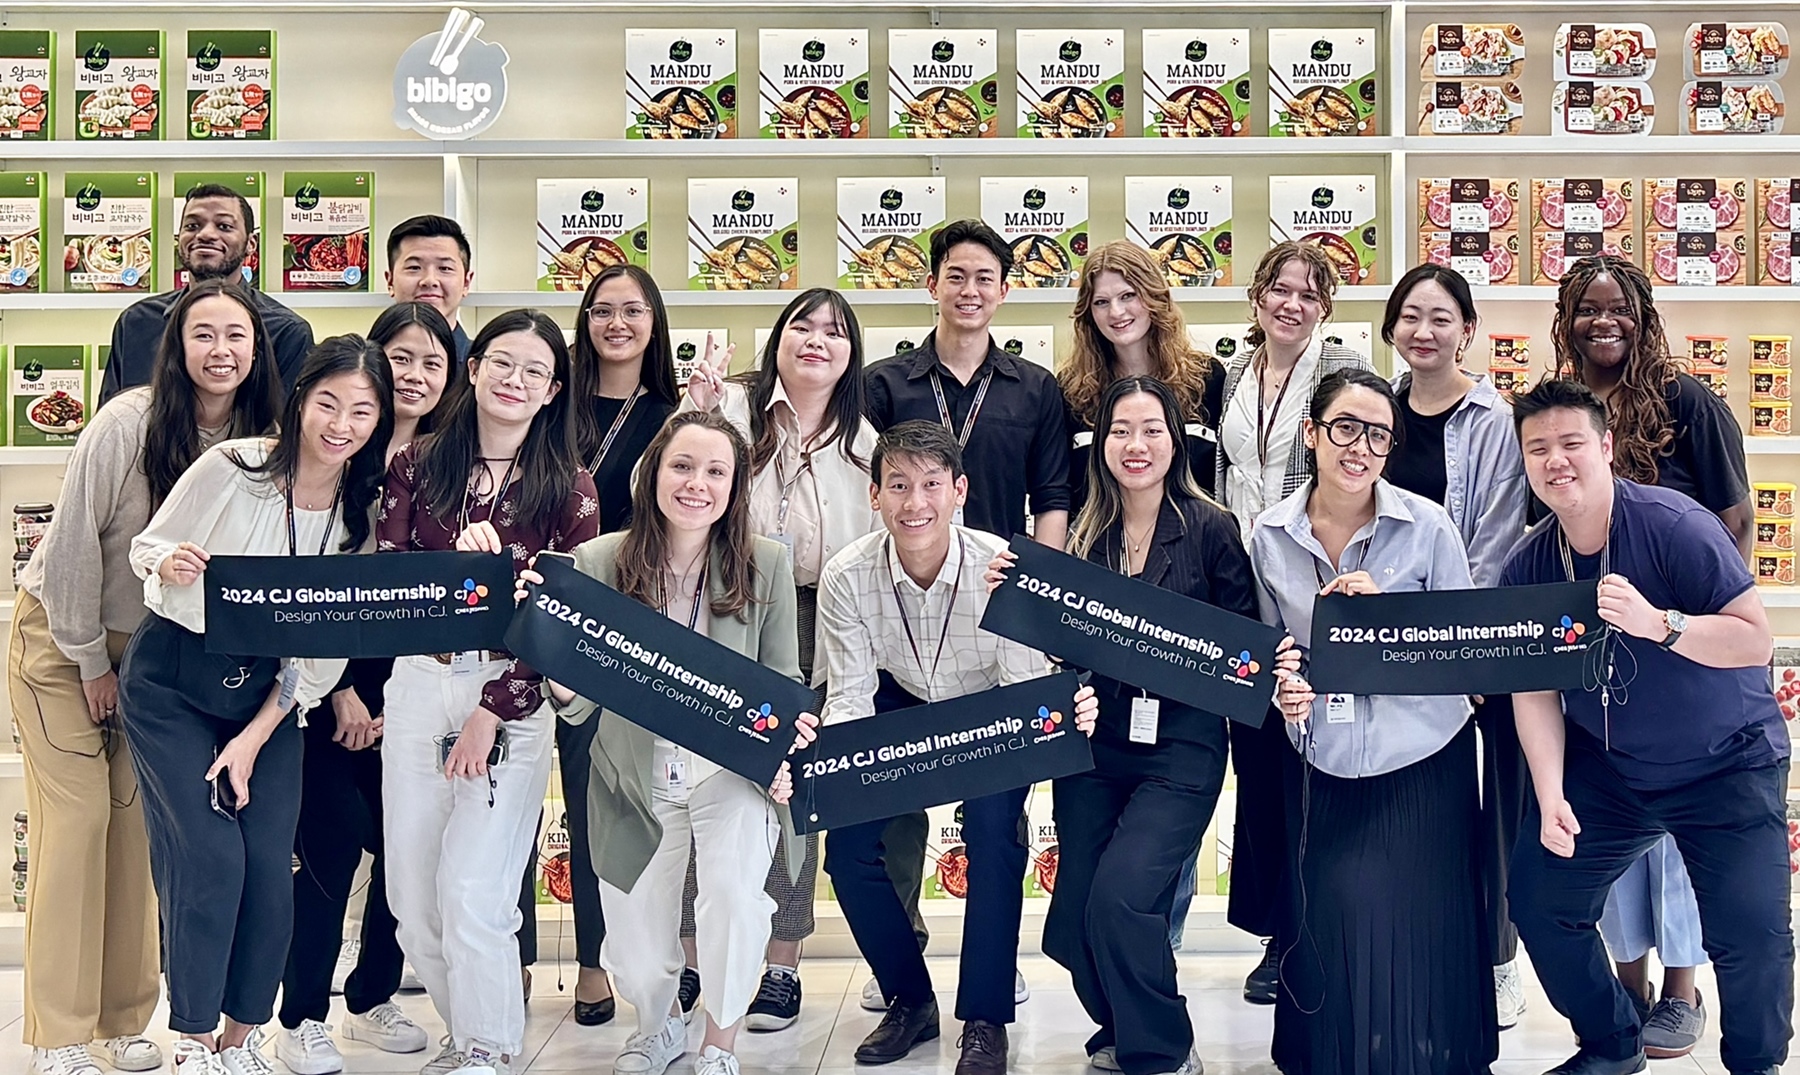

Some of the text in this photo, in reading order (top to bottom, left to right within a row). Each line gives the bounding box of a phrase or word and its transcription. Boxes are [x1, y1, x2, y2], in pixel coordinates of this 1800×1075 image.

[10, 66, 47, 82] 왕교자
[120, 65, 158, 82] 왕교자
[232, 65, 269, 82] 왕교자
[650, 65, 712, 78] MANDU
[784, 65, 844, 78] MANDU
[913, 65, 973, 78] MANDU
[1041, 65, 1100, 78] MANDU
[1166, 64, 1226, 77] MANDU
[1292, 64, 1352, 77] MANDU
[80, 73, 114, 84] 비비고
[192, 73, 225, 84] 비비고
[407, 77, 491, 111] bibigo
[72, 213, 105, 223] 비비고
[291, 212, 323, 222] 비비고
[561, 215, 623, 228] MANDU
[712, 214, 774, 227] MANDU
[861, 213, 922, 227] MANDU
[1005, 212, 1065, 226] MANDU
[1149, 212, 1209, 225] MANDU
[1293, 211, 1352, 224] MANDU
[221, 582, 447, 604] 2024 CJ Global Internship
[454, 589, 468, 601] CJ
[274, 610, 322, 624] Design
[323, 609, 357, 622] Your
[358, 607, 411, 621] Growth
[413, 607, 426, 618] in
[1016, 574, 1224, 661] 2024 CJ Global Internship
[1329, 620, 1545, 643] 2024 CJ Global Internship
[1552, 627, 1566, 639] CJ
[1060, 612, 1103, 637] Design
[1105, 628, 1135, 648] Your
[1135, 640, 1184, 666] Growth
[1184, 656, 1197, 670] in
[535, 594, 744, 710] 2024 CJ Global Internship
[1382, 649, 1426, 664] Design
[1428, 648, 1458, 661] Your
[1460, 645, 1510, 660] Growth
[1512, 644, 1525, 656] in
[1228, 657, 1242, 669] CJ
[575, 638, 619, 670] Design
[621, 661, 652, 684] Your
[651, 678, 701, 710] Growth
[700, 702, 714, 717] in
[746, 708, 761, 722] CJ
[1030, 717, 1043, 729] CJ
[802, 716, 1023, 779] 2024 CJ Global Internship
[860, 767, 907, 785] Design
[907, 758, 939, 774] Your
[941, 746, 992, 767] Growth
[993, 743, 1006, 754] in
